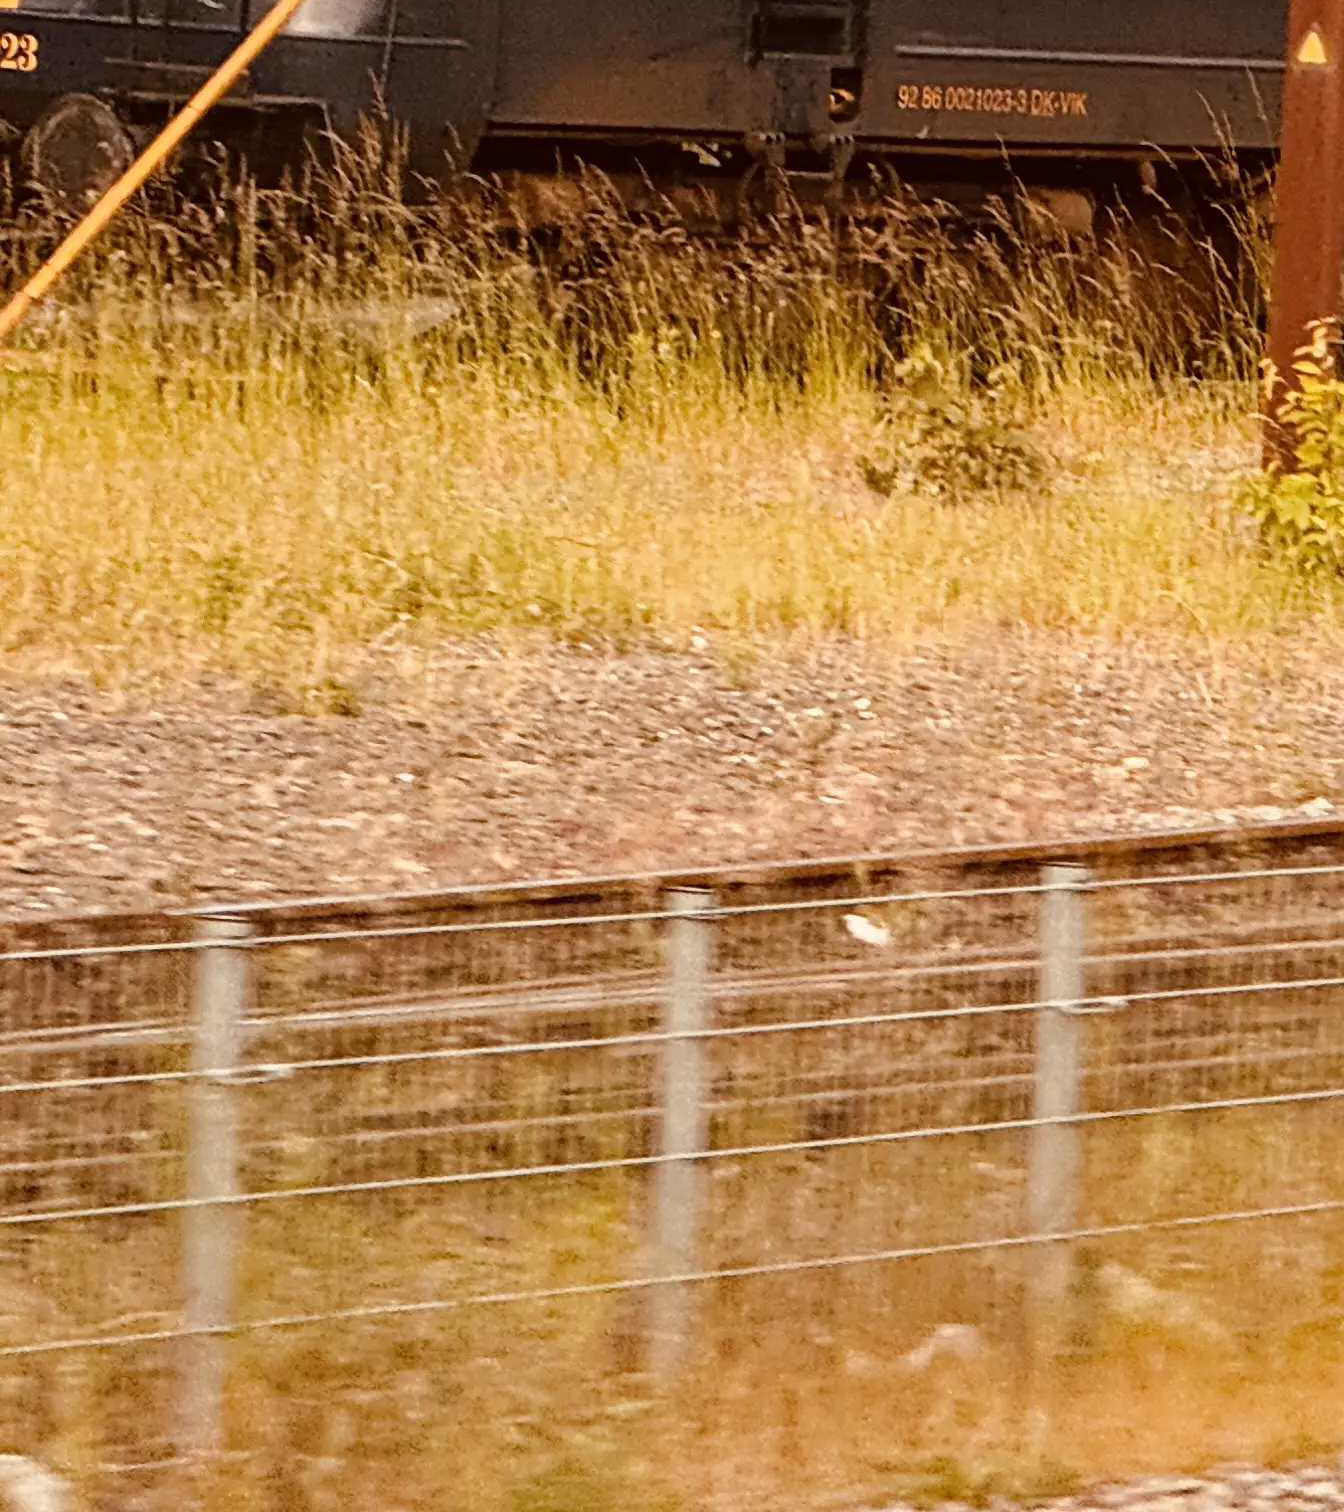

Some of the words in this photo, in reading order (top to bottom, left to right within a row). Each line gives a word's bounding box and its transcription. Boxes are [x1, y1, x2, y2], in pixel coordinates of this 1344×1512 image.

[0, 32, 38, 71] 23
[898, 85, 918, 108] 92
[945, 87, 1027, 113] 0021023-3
[1031, 89, 1087, 116] DK-VIK
